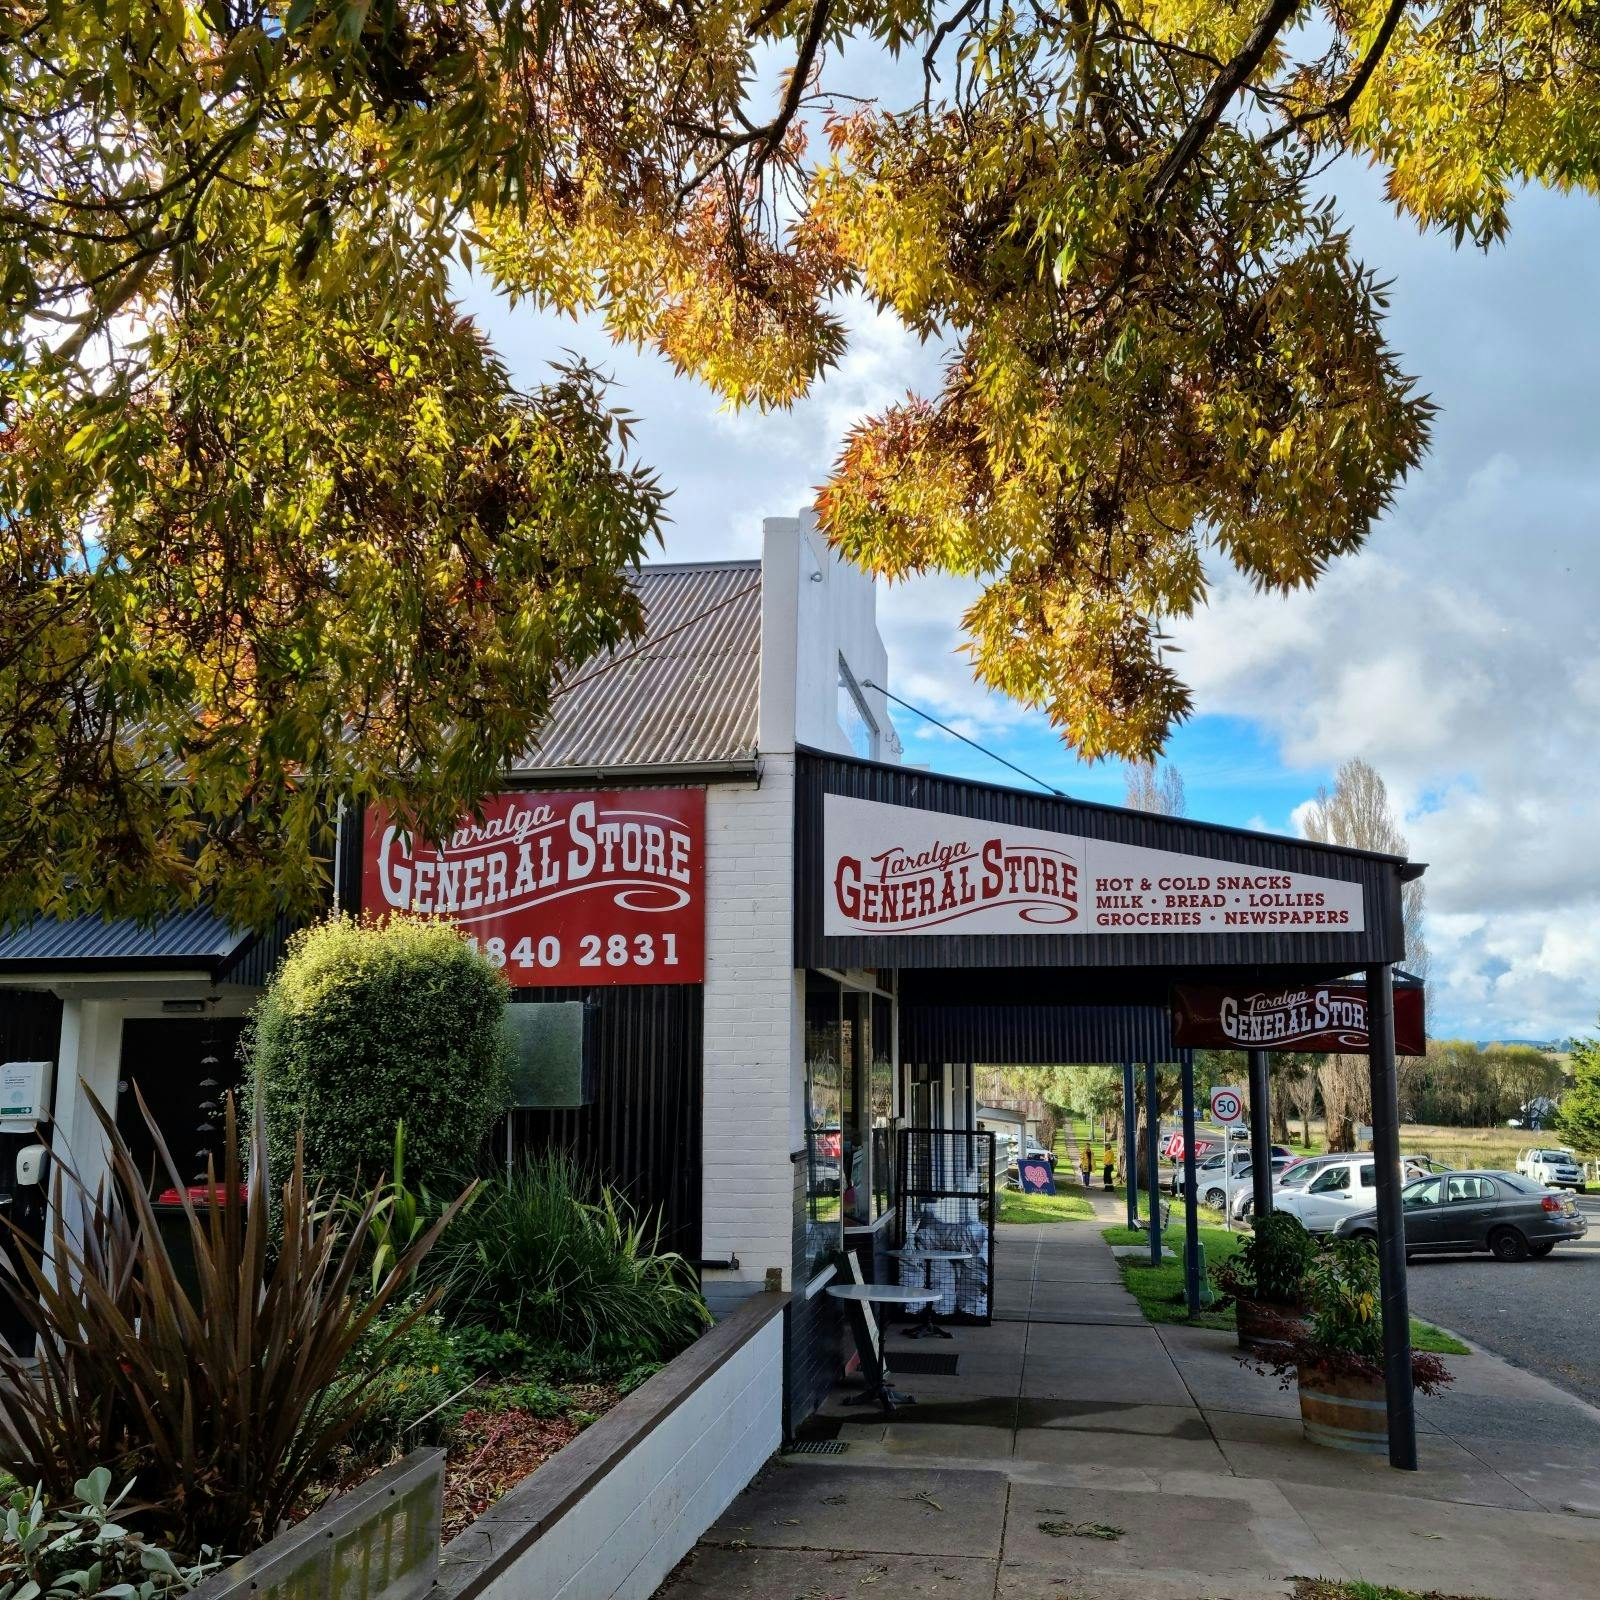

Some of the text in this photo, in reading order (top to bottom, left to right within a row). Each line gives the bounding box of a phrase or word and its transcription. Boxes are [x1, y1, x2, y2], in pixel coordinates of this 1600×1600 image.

[437, 803, 554, 862] aralga
[377, 800, 690, 913] GENERAL STORE
[870, 840, 970, 884] Taralga
[834, 838, 1078, 923] GENERAL STORE
[1095, 876, 1292, 892] HOT & COLD SNACKS
[1096, 893, 1325, 909] MILK BREAD LOLLIES
[1096, 910, 1350, 926] GROCERIES NEWSPAPERS
[579, 933, 679, 967] 2831
[1220, 990, 1369, 1041] GENERAL STOR
[1244, 990, 1308, 1016] Taralga
[1218, 1100, 1236, 1113] 50
